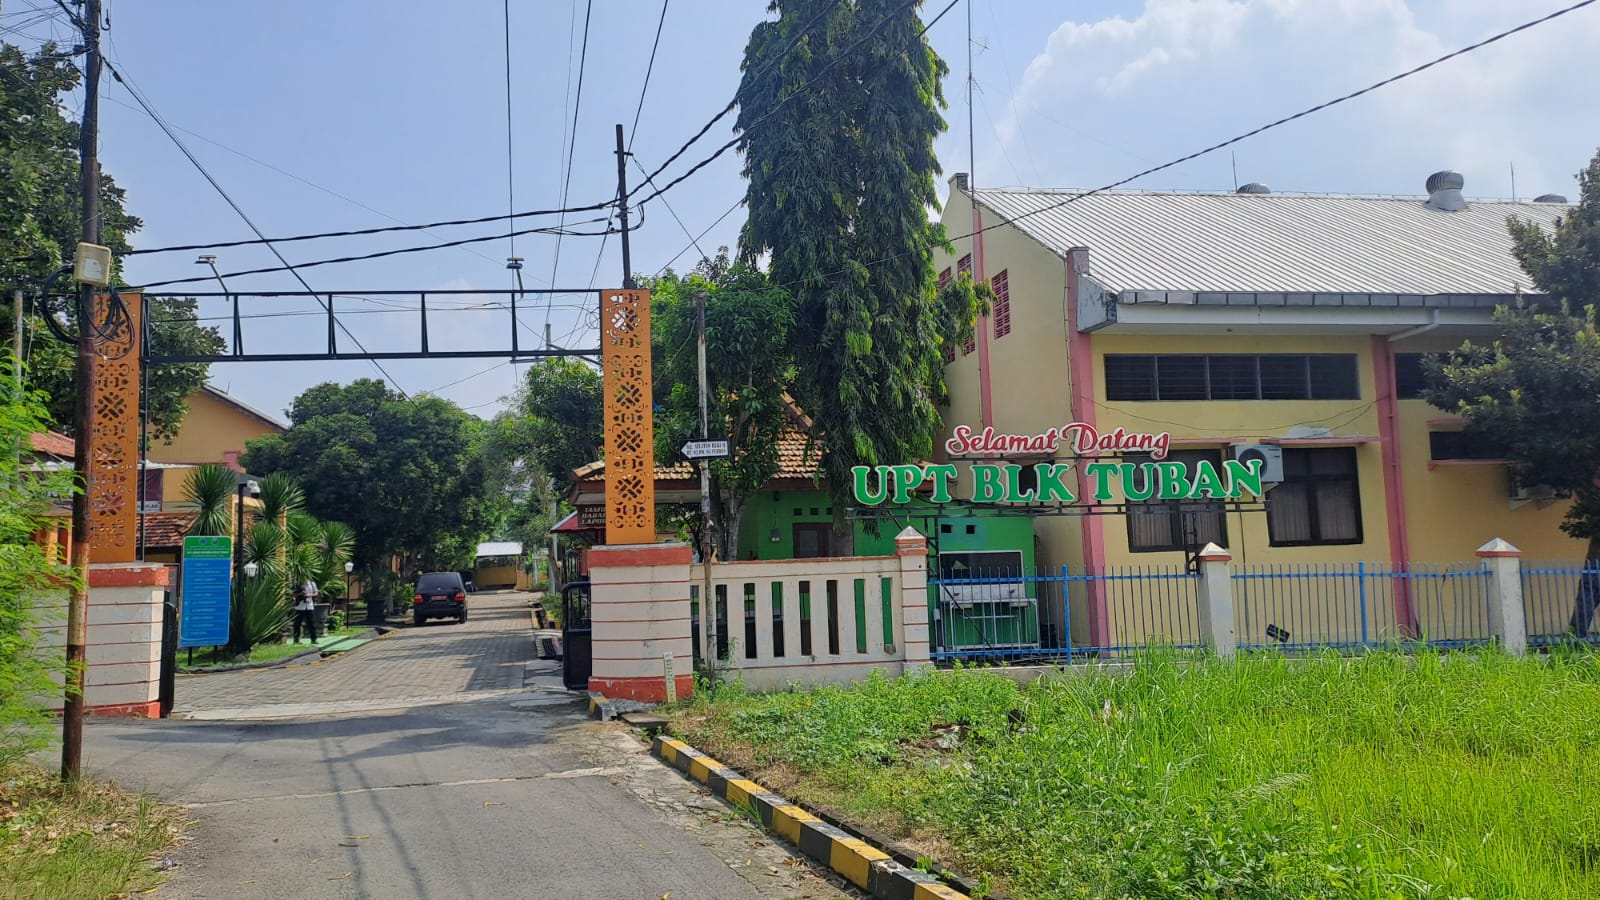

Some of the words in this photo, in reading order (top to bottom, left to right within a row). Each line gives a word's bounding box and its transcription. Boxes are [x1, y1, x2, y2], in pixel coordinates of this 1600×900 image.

[946, 424, 1058, 455] Selamat
[1061, 423, 1170, 459] Datang
[851, 463, 957, 505] UPT
[970, 463, 1075, 503] BLK
[1085, 459, 1263, 501] TUBAN
